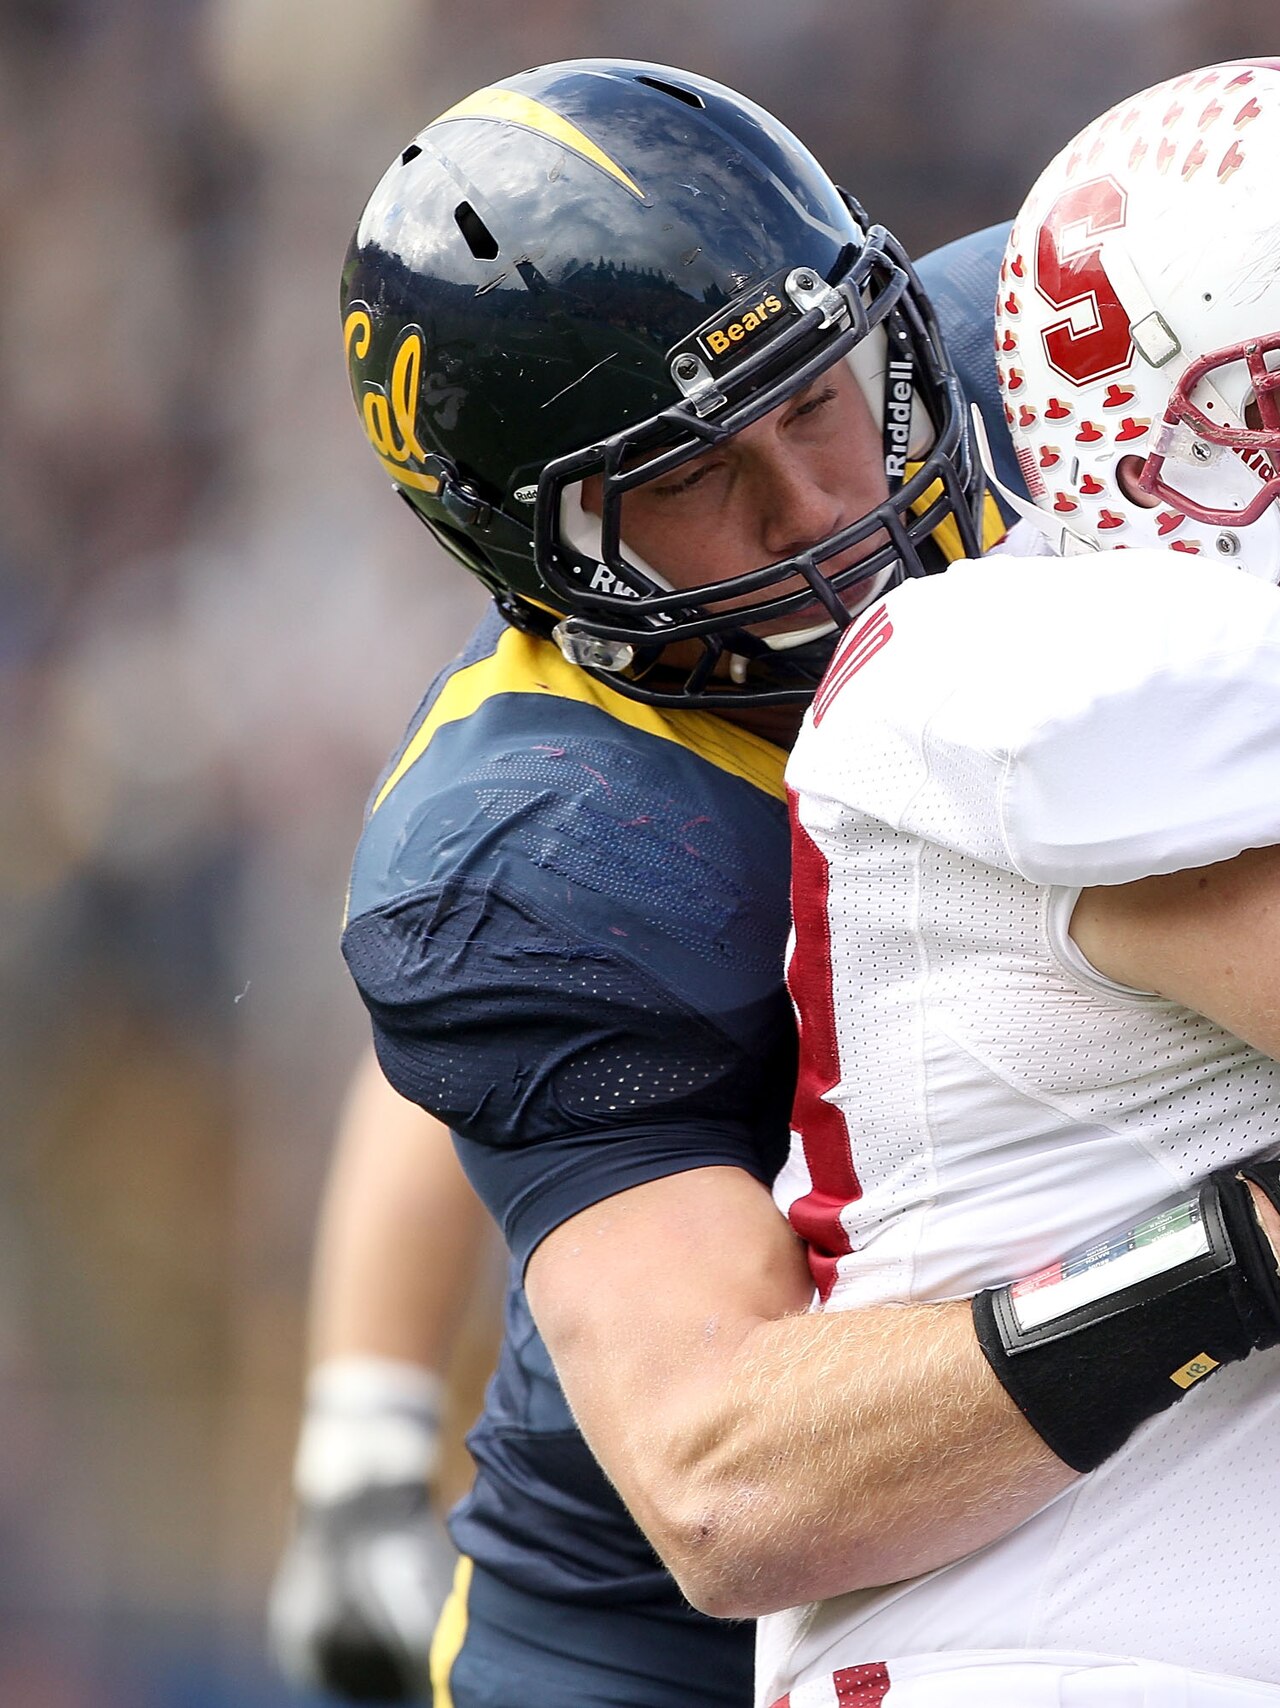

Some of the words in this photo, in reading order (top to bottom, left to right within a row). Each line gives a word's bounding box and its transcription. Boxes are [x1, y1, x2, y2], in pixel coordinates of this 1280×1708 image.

[706, 295, 782, 354] Bears
[1034, 174, 1136, 388] S
[344, 311, 434, 480] Cal
[885, 360, 913, 477] Riddell
